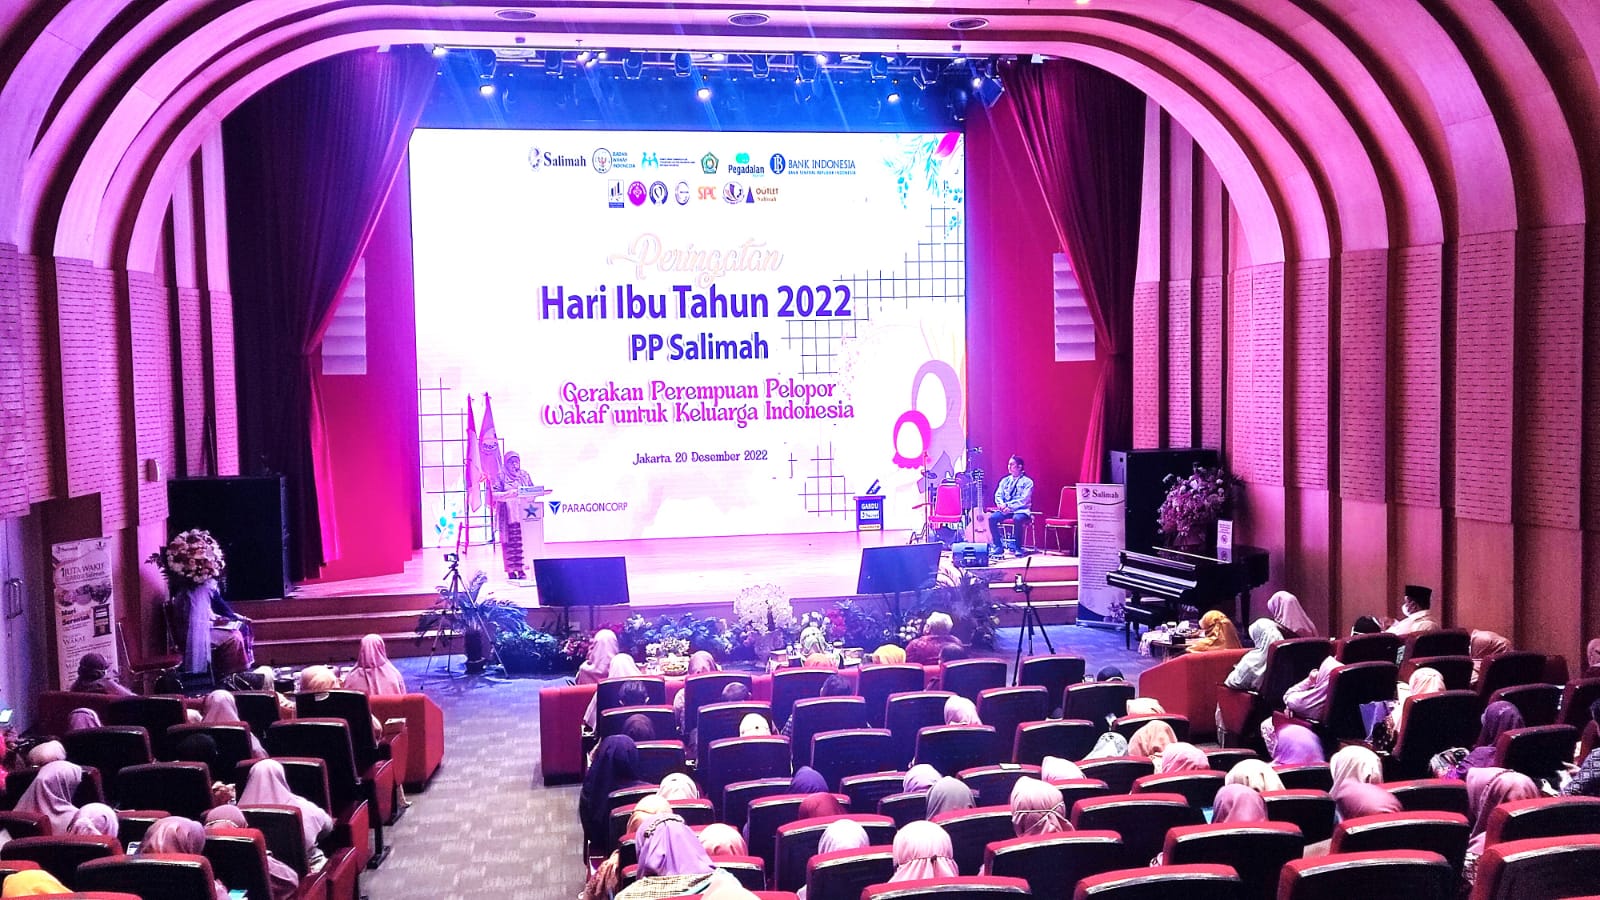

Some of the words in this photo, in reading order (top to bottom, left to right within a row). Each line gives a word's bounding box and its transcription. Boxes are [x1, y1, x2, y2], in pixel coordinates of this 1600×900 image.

[543, 151, 587, 167] Salimah
[788, 159, 810, 169] BANK
[812, 159, 856, 169] INDONESIA
[697, 186, 717, 200] SPC
[607, 232, 785, 288] Peringatan
[541, 284, 607, 320] Hari
[616, 284, 667, 320] Ibu
[672, 284, 769, 319] Tahun
[777, 285, 852, 318] 2022
[632, 334, 664, 361] PP
[669, 332, 769, 361] Salimah
[562, 381, 644, 406] Gerakan
[651, 380, 759, 407] Perempuan
[765, 378, 837, 406] Pelopor
[544, 403, 610, 425] Wakaf
[614, 402, 669, 423] untuk
[675, 401, 759, 429] Keluarga
[765, 400, 855, 420] Indonesia
[675, 451, 688, 463] 20
[691, 450, 741, 463] Desember
[743, 450, 768, 461] 2022
[1092, 489, 1119, 499] Salimah
[562, 502, 628, 513] PARAGONCORP
